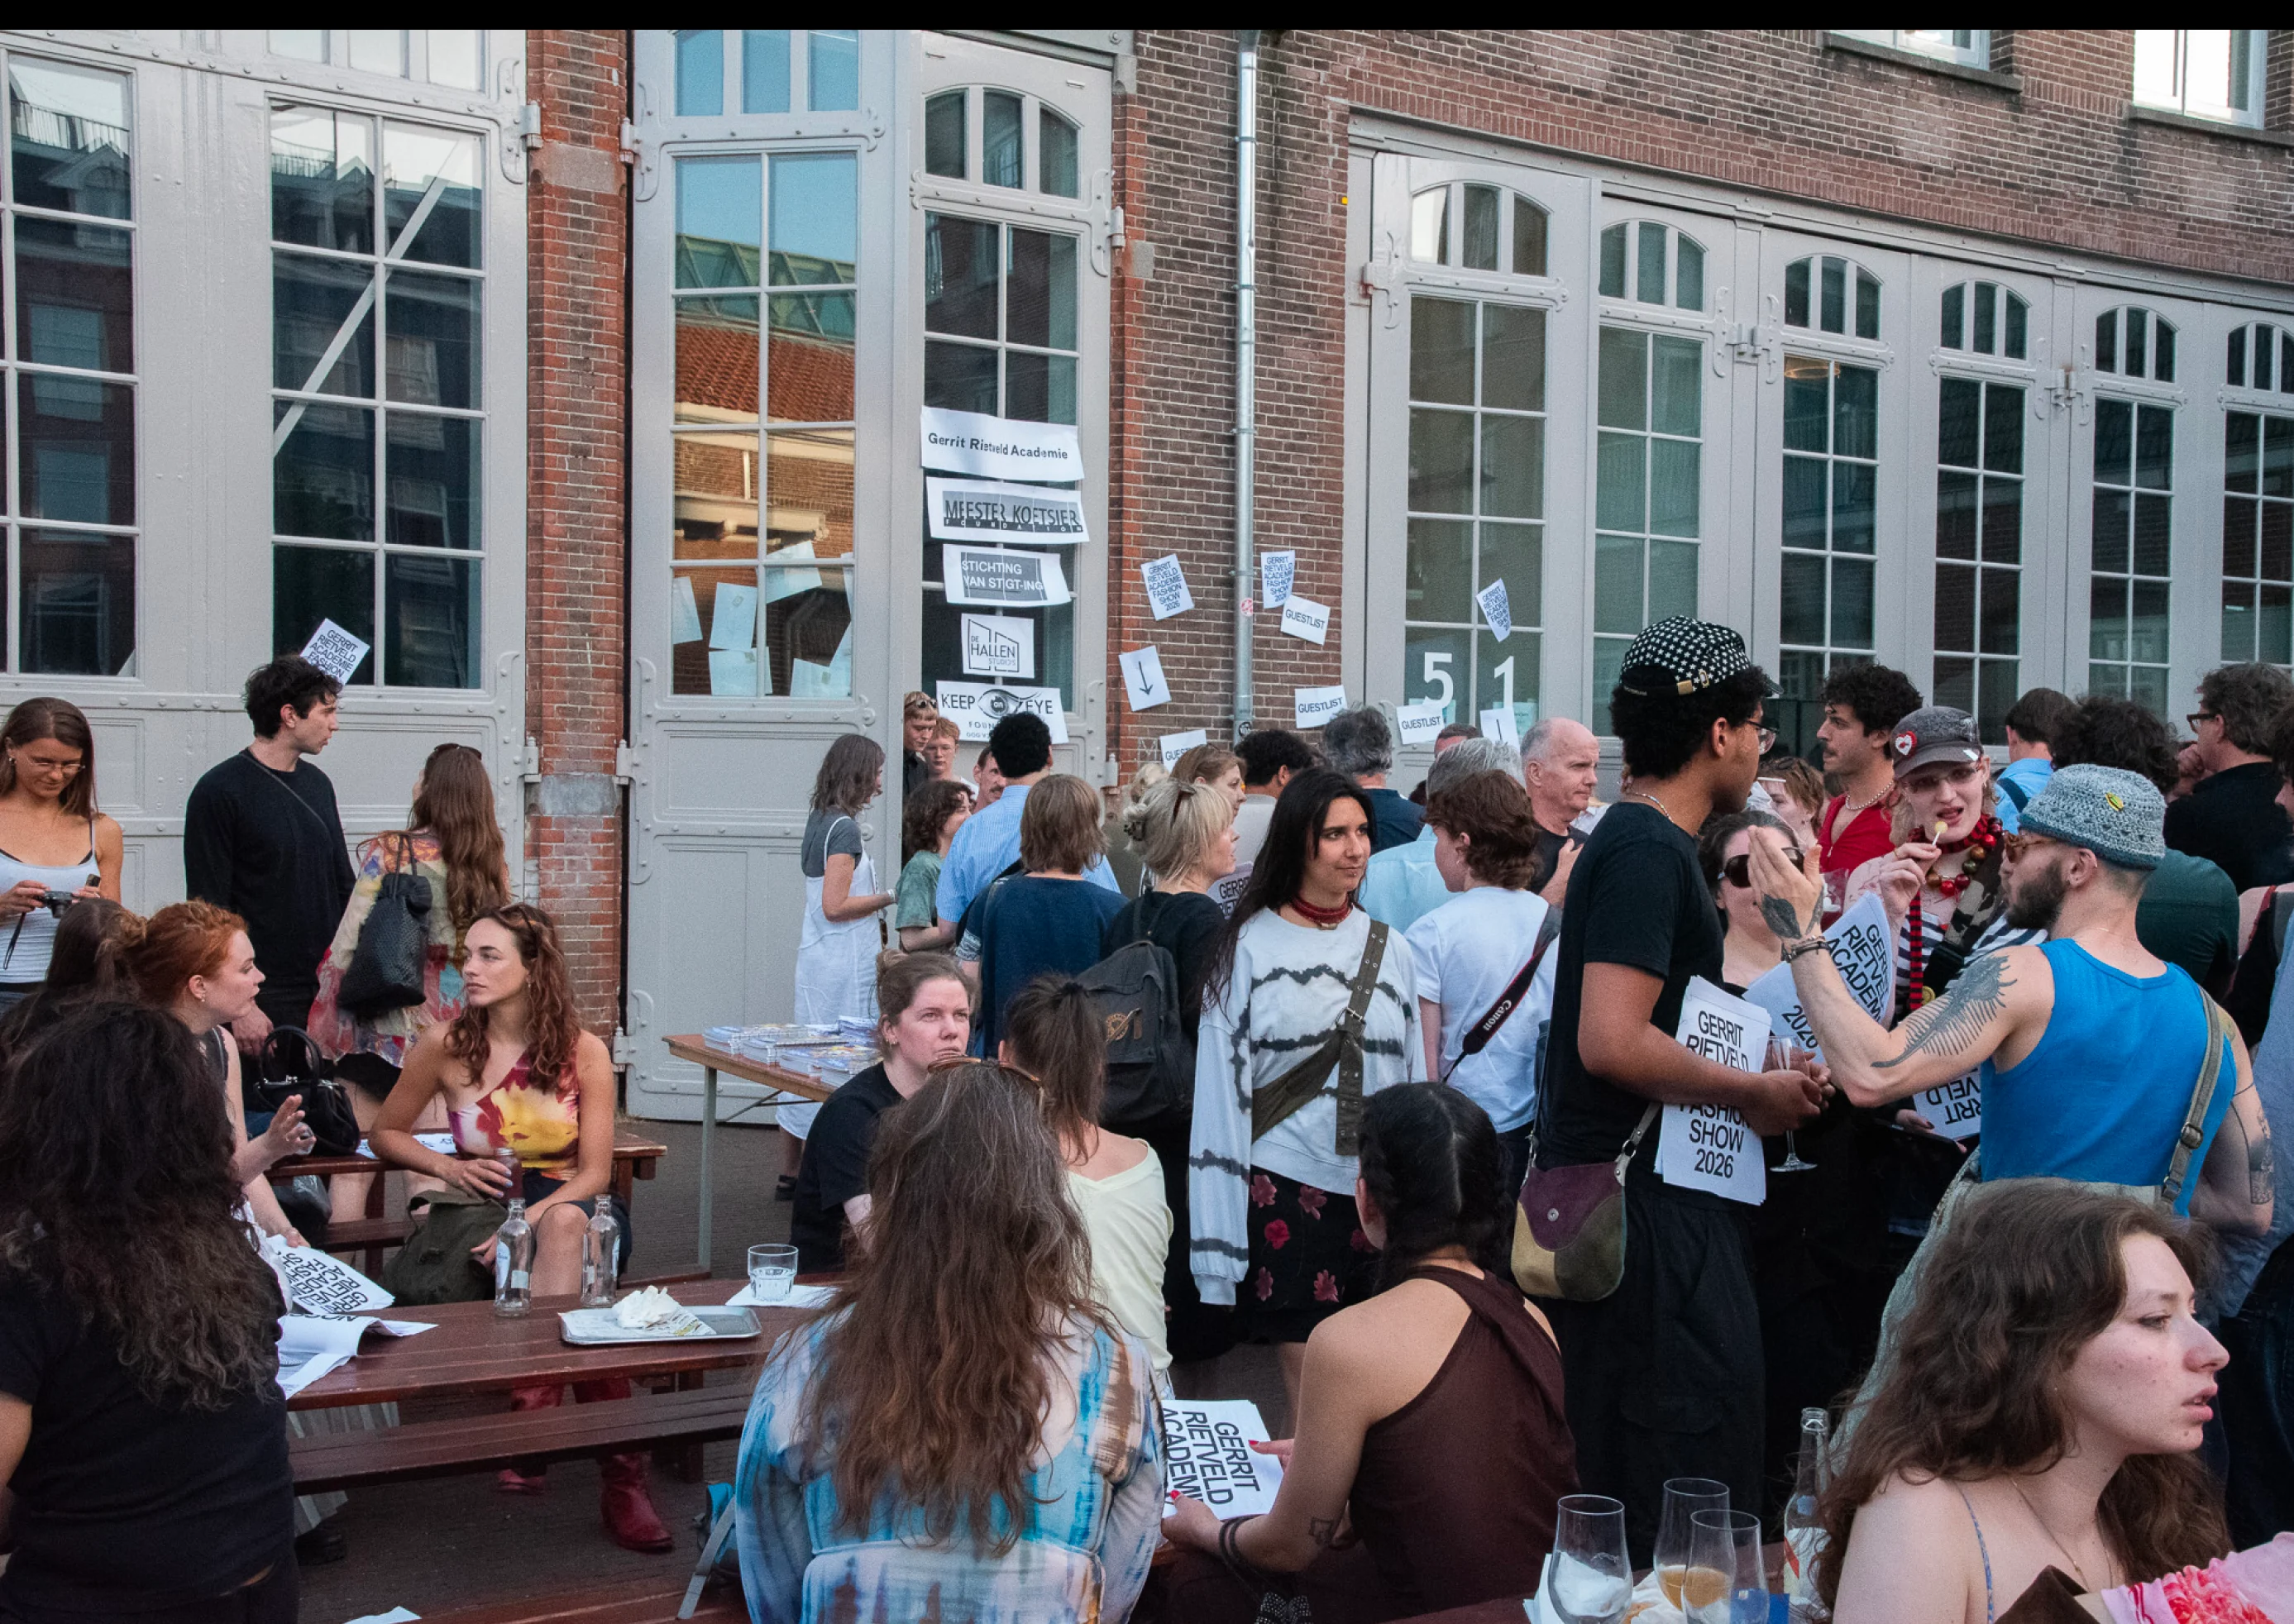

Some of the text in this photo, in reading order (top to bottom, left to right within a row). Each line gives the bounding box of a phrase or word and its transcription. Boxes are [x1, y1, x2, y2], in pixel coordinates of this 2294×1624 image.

[928, 432, 966, 449] Gerrit
[1011, 445, 1068, 460] Academie
[944, 499, 1079, 527] MEESTER KOETSIER
[961, 560, 1022, 575] STICHTING
[1149, 561, 1171, 575] GERRIT
[1266, 556, 1288, 565] GERRIT
[963, 576, 986, 588] VAN
[1147, 567, 1178, 584] RIETVELD
[1149, 575, 1182, 592] ACADEMIE
[1152, 583, 1182, 599] FASHION
[1159, 591, 1180, 604] SHOW
[1285, 609, 1326, 629] GUESTLIST
[318, 634, 356, 662] RIETVELD
[327, 629, 358, 652] GERRIT
[970, 643, 1016, 659] HALLEN
[309, 642, 353, 671] ACADEMIE
[1422, 652, 1514, 709] 5 1
[941, 694, 977, 710] KEEP
[1025, 699, 1054, 714] EYE
[1298, 696, 1343, 714] GUESTLIST
[1402, 716, 1441, 730] GUESTLIST
[1219, 876, 1250, 900] GERR
[1841, 924, 1887, 1005] RIETVEL
[1483, 1000, 1512, 1031] Canon
[1698, 1010, 1744, 1048] GERRIT
[1679, 1103, 1751, 1129] ASHIO
[1689, 1119, 1745, 1154] SHOW
[1694, 1149, 1734, 1179] 2026
[1161, 1407, 1205, 1502] ACADEMI
[1182, 1411, 1234, 1505] RIETVELD
[1213, 1421, 1261, 1492] GERRIT
